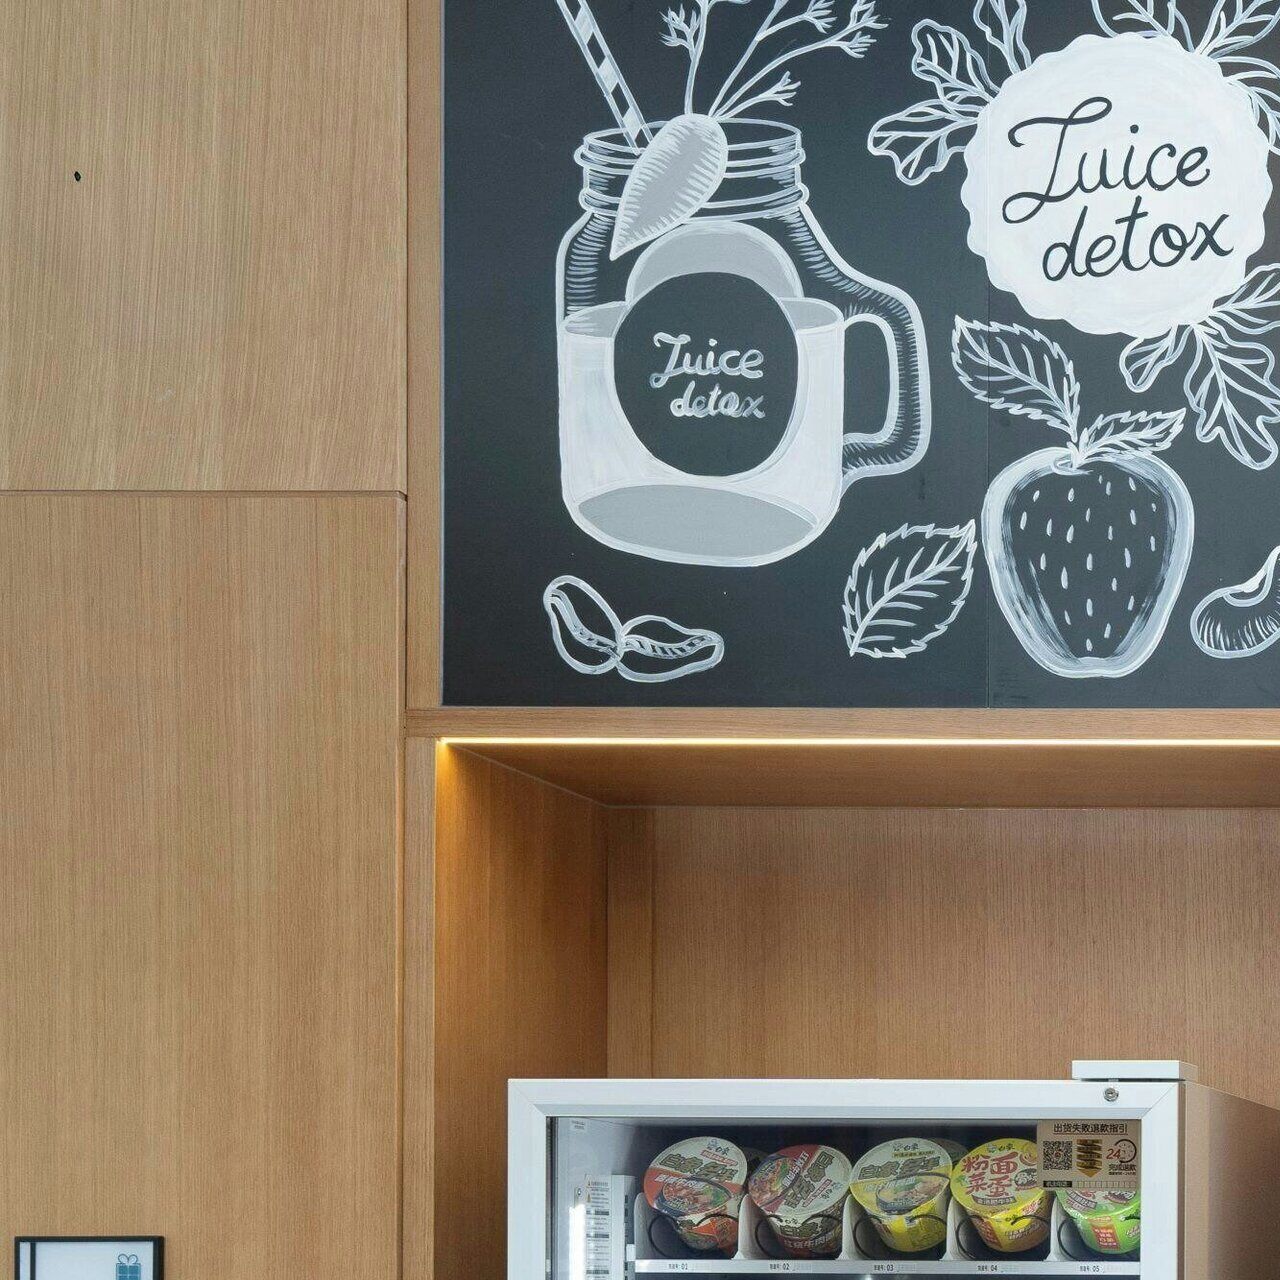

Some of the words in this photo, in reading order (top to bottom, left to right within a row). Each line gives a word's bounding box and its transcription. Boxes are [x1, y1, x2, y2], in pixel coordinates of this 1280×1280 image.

[1042, 195, 1234, 282] detox
[650, 331, 764, 388] Juice
[669, 381, 766, 419] detox
[1106, 1148, 1120, 1160] 24
